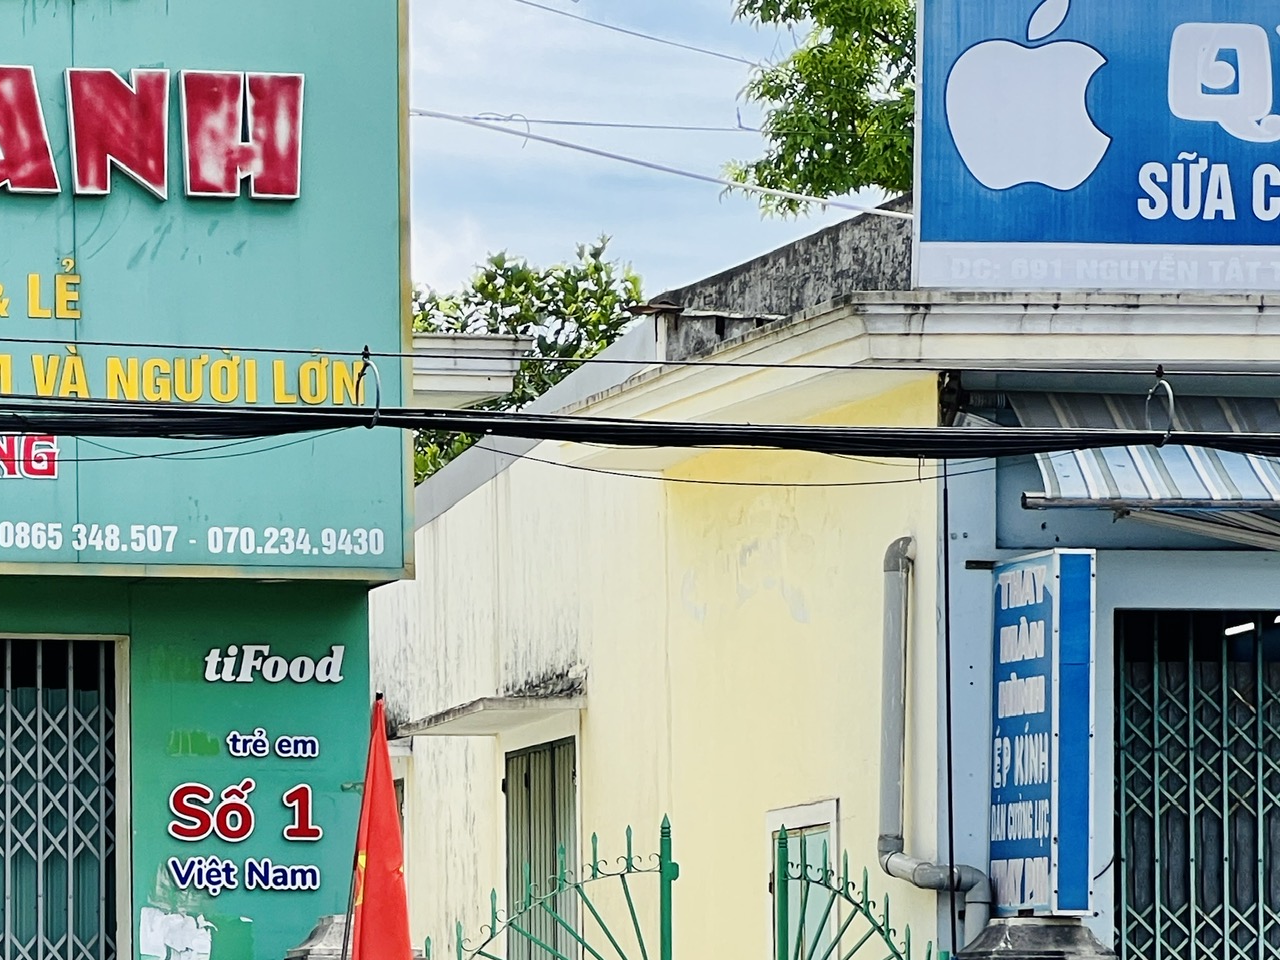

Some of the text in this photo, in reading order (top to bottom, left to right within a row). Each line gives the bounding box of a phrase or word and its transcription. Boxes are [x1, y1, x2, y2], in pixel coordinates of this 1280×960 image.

[1137, 151, 1236, 221] SỮA
[27, 258, 82, 320] LẺ
[31, 344, 91, 399] VÀ
[106, 347, 257, 404] NGƯỜI
[72, 522, 179, 553] 348.507
[207, 526, 385, 556] 070.234.9430
[998, 565, 1047, 610] THAY
[204, 645, 345, 683] tiFood
[227, 728, 319, 757] trẻ em
[993, 722, 1049, 788] ÉP KÍNH
[169, 778, 323, 841] Số 1
[169, 856, 320, 896] Việt Nam
